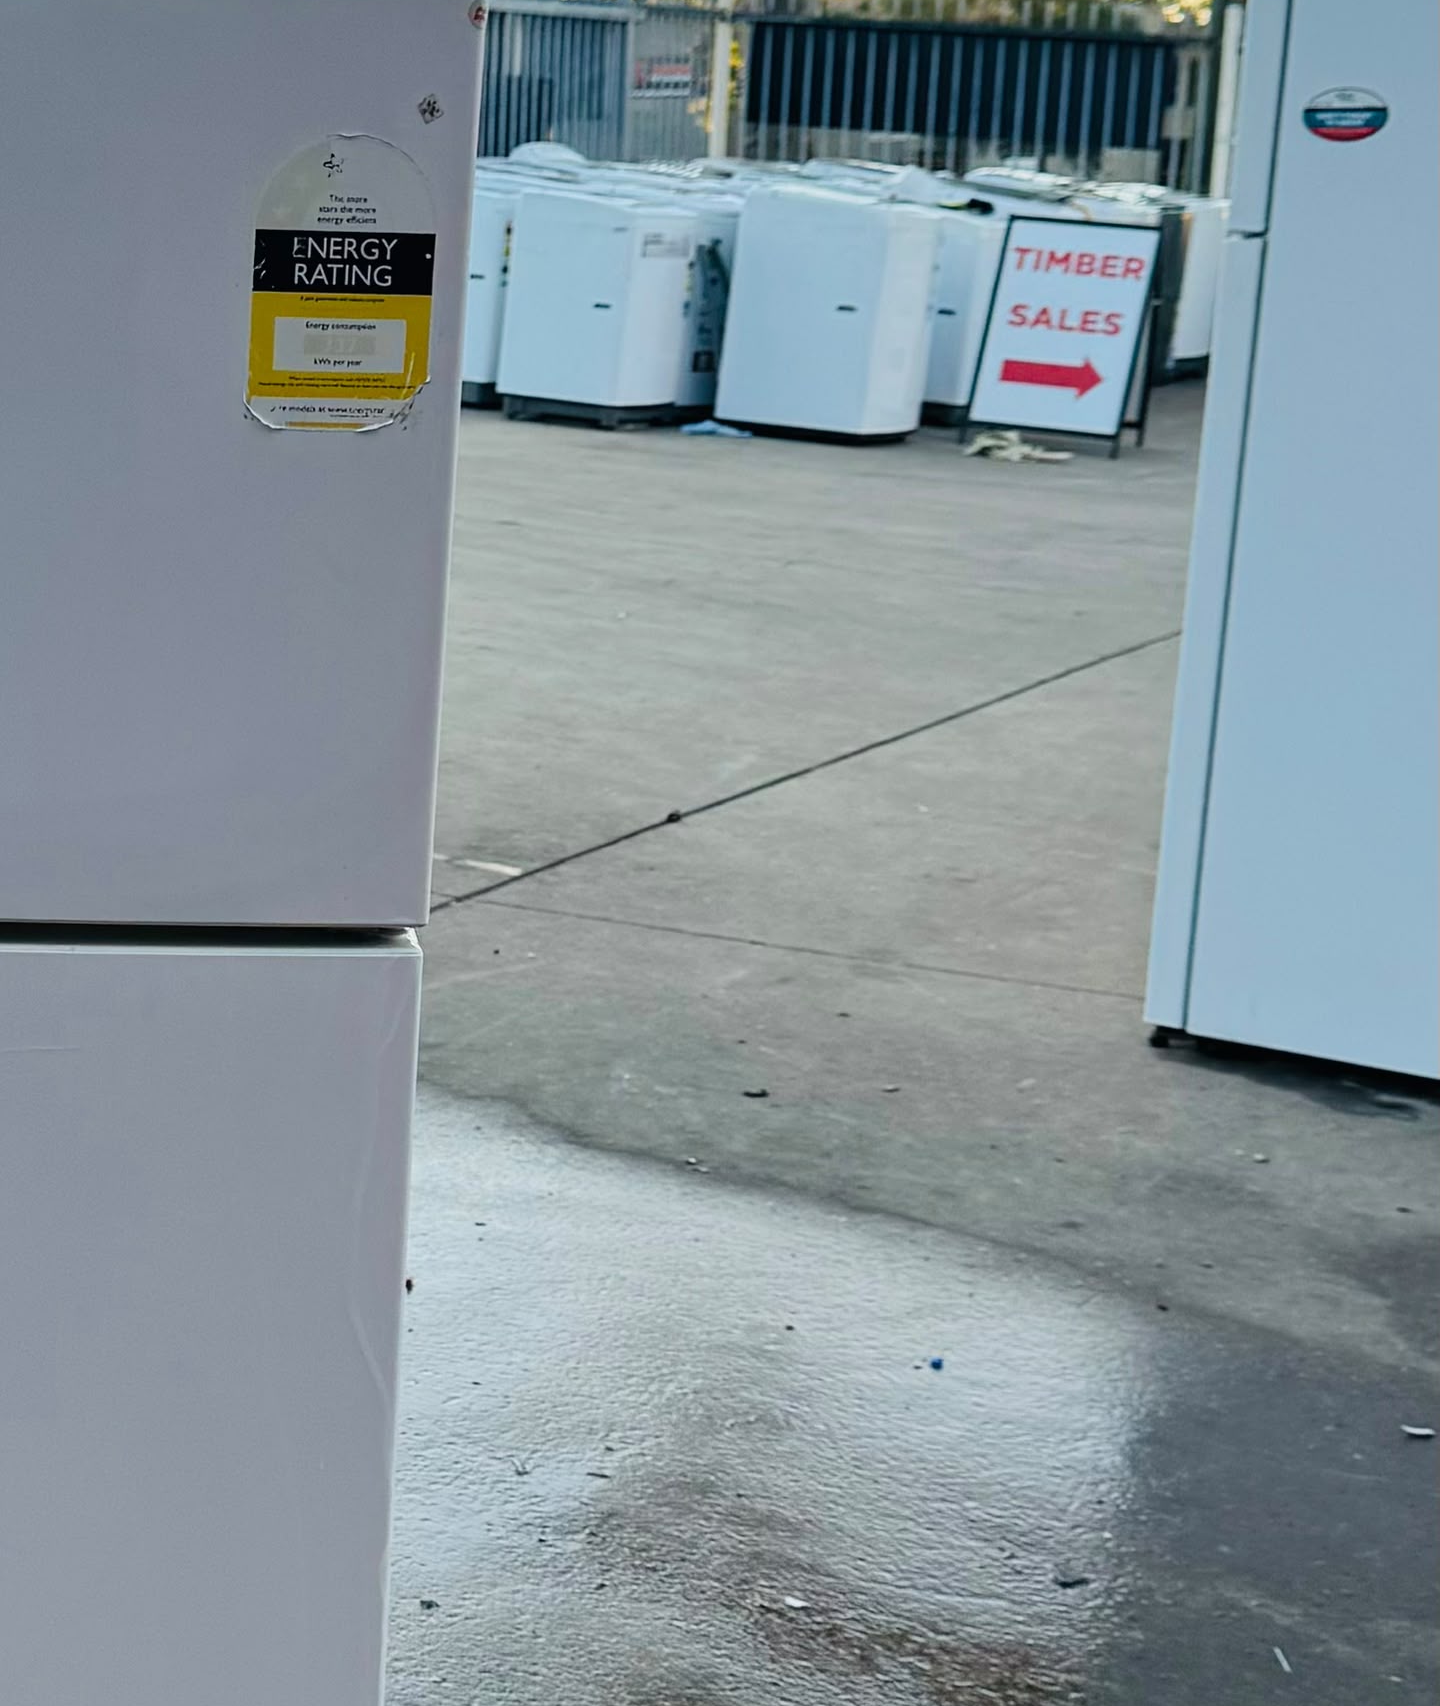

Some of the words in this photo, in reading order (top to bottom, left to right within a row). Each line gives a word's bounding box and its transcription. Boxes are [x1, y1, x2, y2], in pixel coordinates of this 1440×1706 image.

[317, 216, 344, 226] energy
[293, 236, 398, 260] ENERGY
[294, 263, 393, 287] RATING
[1014, 246, 1146, 281] TIMBER
[305, 320, 330, 331] Energy
[1008, 303, 1124, 336] SALES
